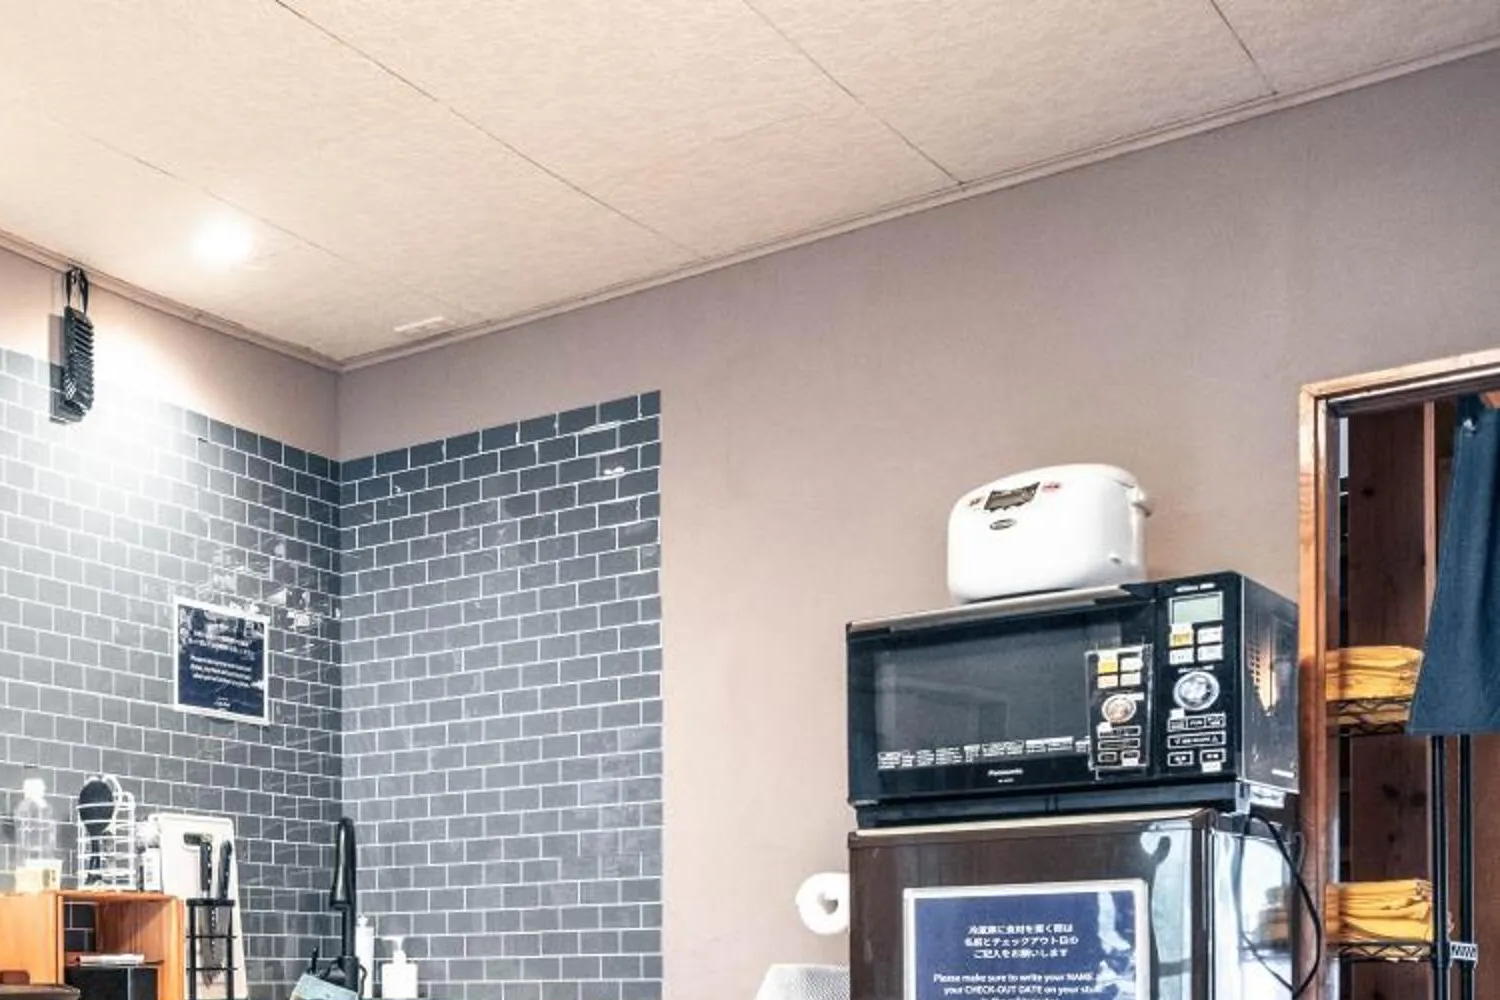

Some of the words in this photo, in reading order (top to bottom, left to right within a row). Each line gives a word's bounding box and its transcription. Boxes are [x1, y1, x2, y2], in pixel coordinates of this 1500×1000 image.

[932, 973, 960, 983] Please
[961, 973, 987, 983] make
[987, 975, 1006, 983] sure
[1007, 973, 1019, 983] to
[1019, 973, 1042, 983] write
[1043, 975, 1065, 985] your
[944, 987, 963, 997] your
[1018, 985, 1042, 995] DATE
[1043, 986, 1057, 994] on
[1058, 986, 1079, 997] your
